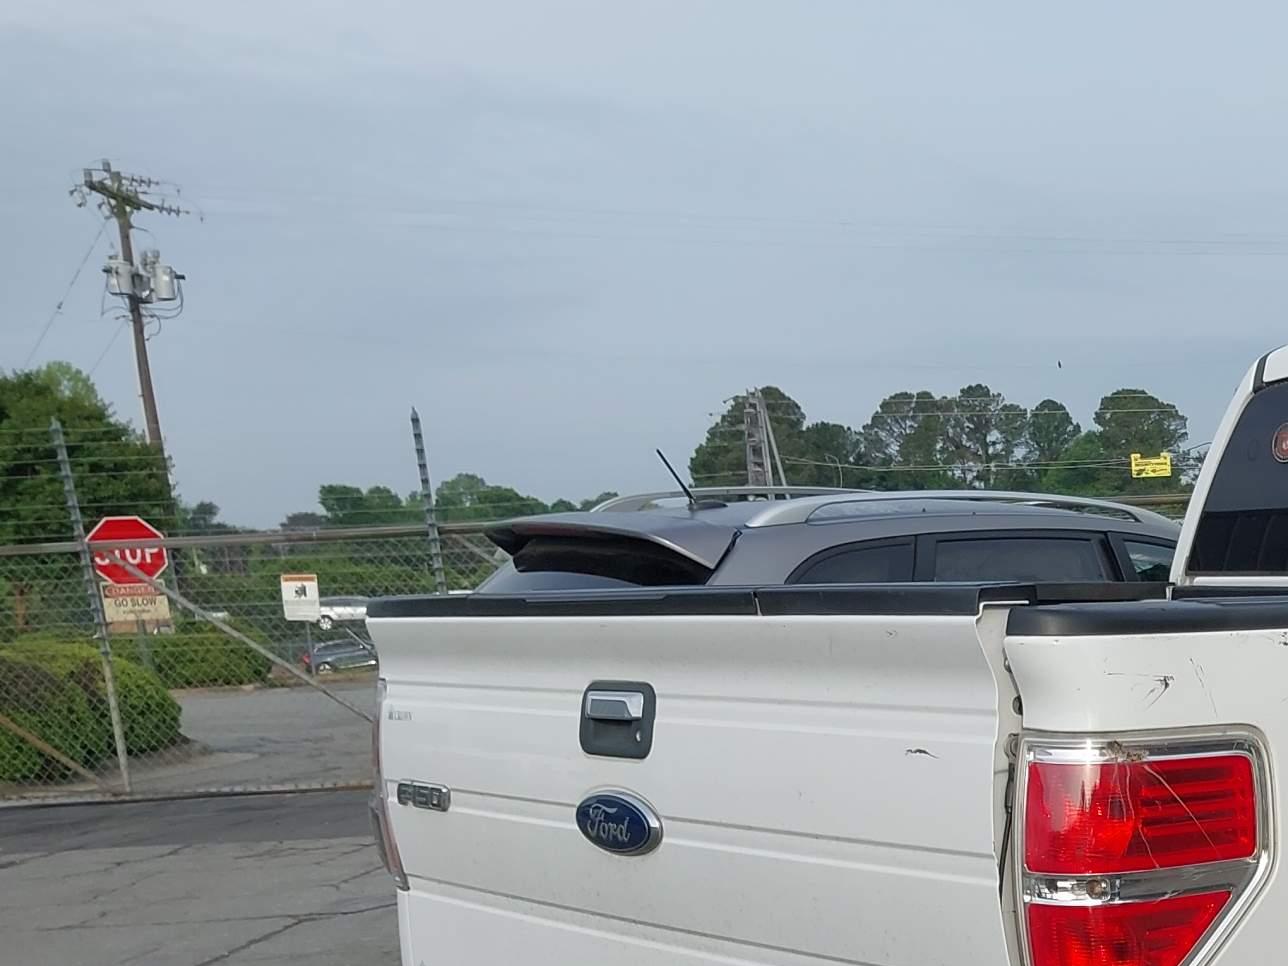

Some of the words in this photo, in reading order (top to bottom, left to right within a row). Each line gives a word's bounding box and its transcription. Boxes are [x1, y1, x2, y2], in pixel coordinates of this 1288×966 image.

[114, 598, 129, 608] GO
[131, 597, 157, 607] SLOW
[586, 803, 631, 843] Ford
